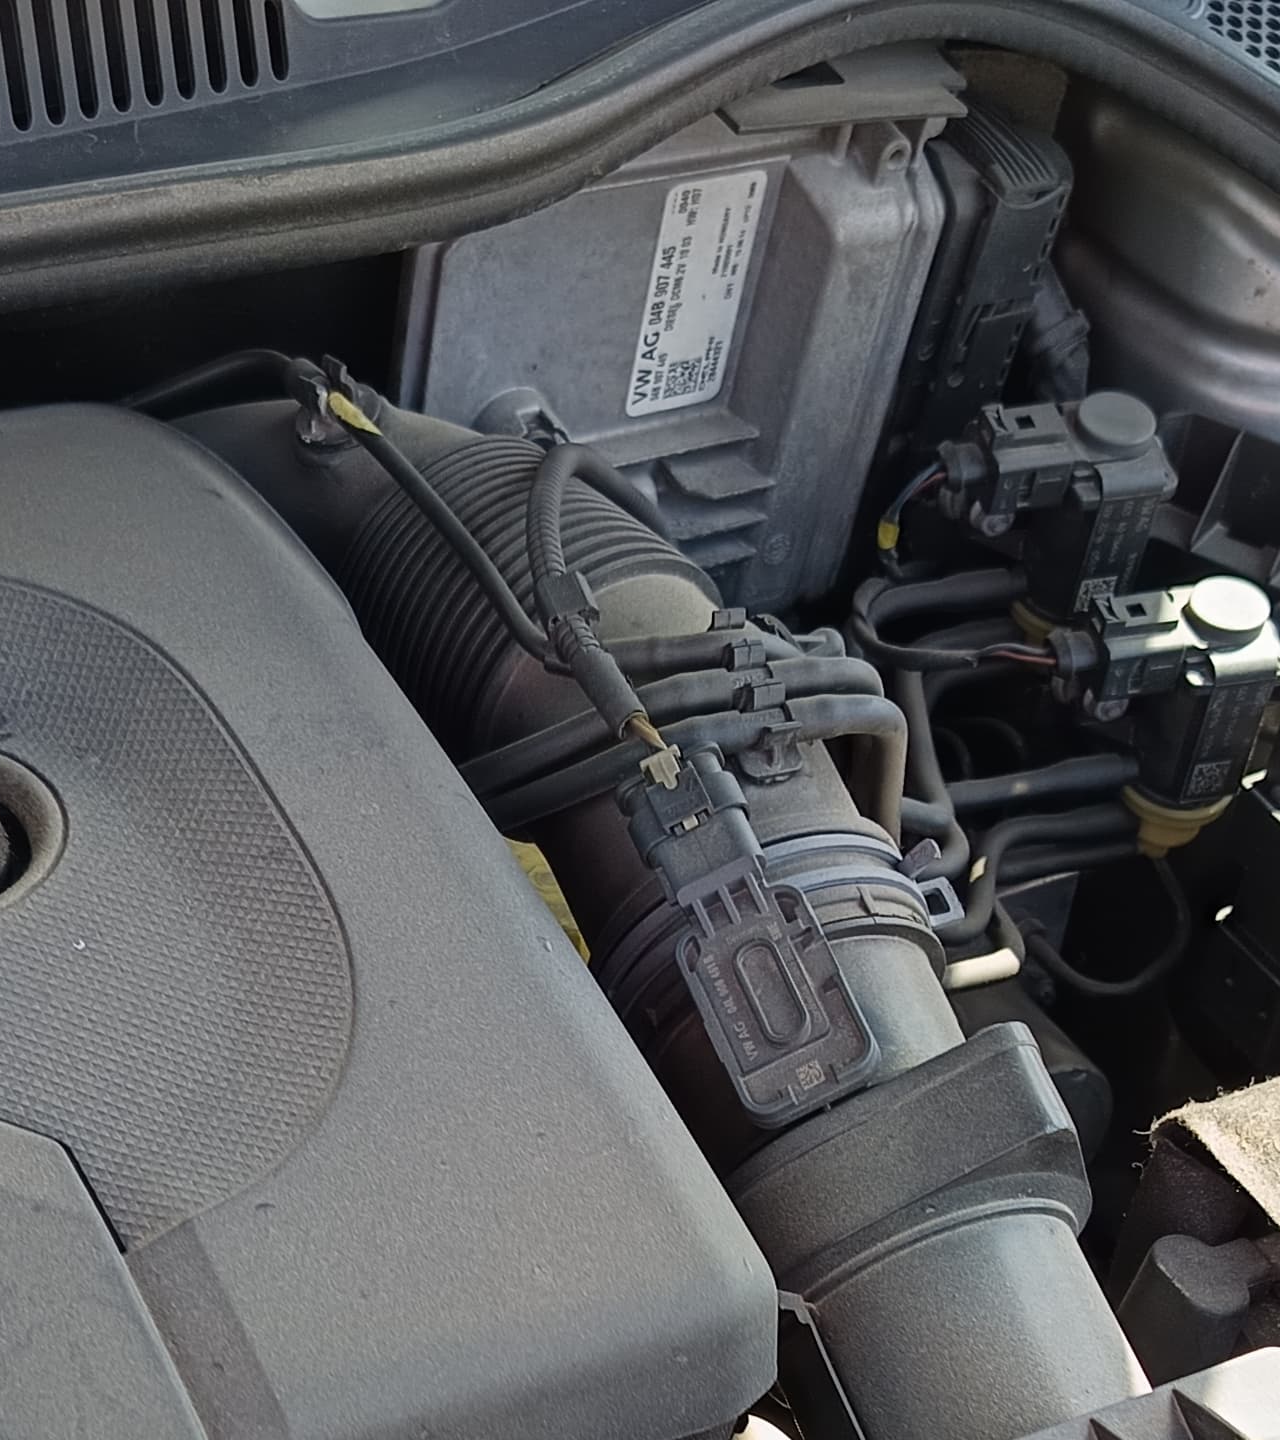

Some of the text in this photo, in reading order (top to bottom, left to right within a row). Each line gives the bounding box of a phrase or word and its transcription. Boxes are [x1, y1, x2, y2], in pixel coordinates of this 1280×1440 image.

[631, 245, 677, 405] VW AG 04B 907 445
